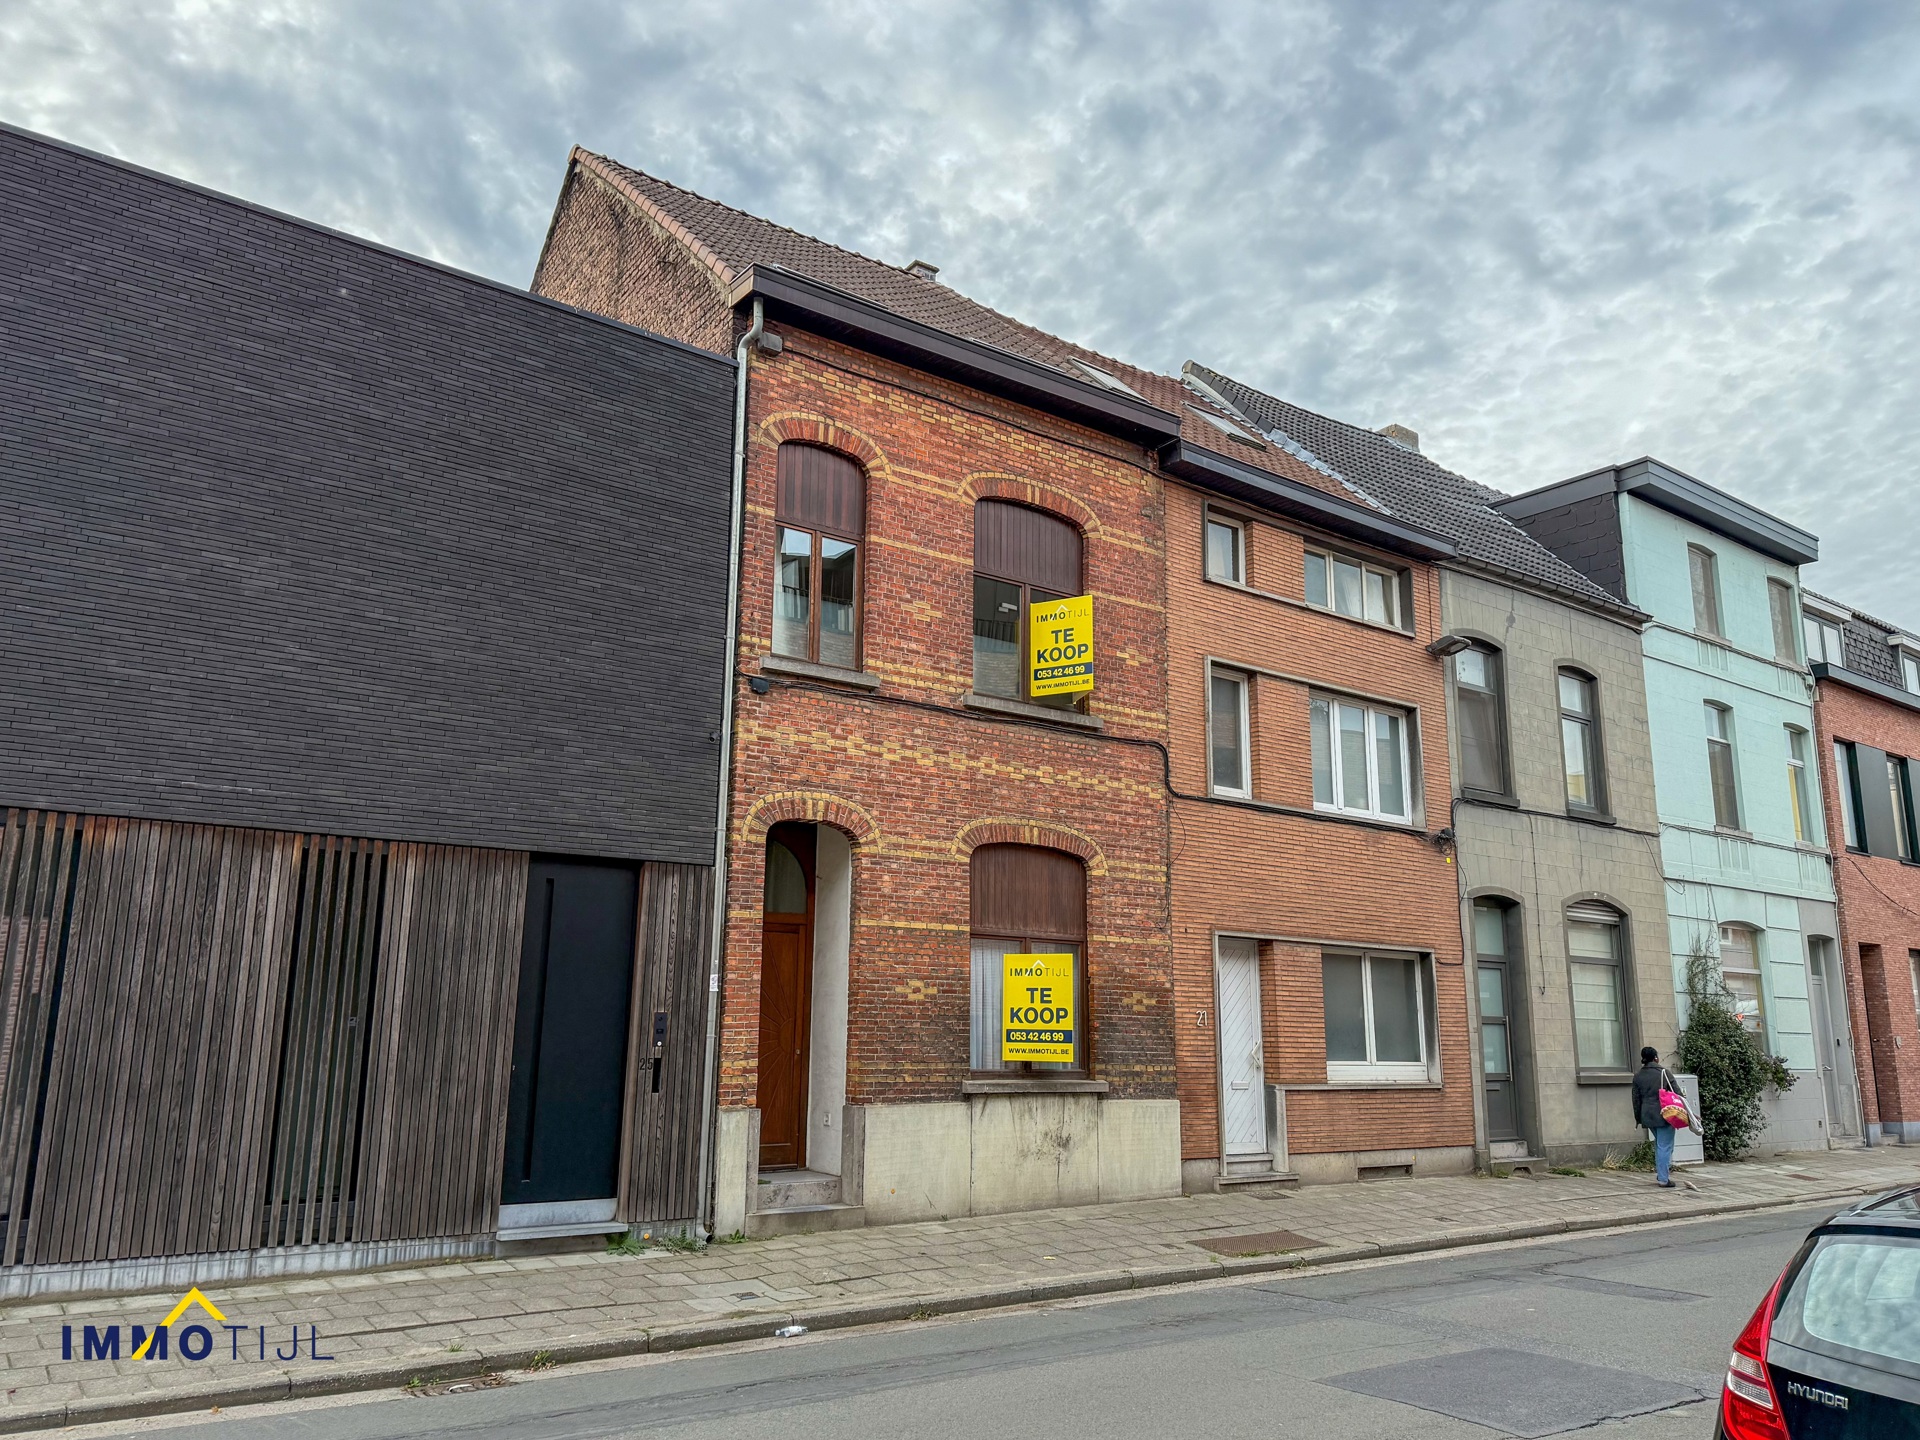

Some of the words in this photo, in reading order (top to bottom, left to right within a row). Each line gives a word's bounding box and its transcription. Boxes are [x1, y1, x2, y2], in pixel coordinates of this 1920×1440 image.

[1036, 608, 1090, 623] IMMOTIJL
[1051, 628, 1075, 644] TE
[1036, 643, 1089, 663] KOOP
[1037, 670, 1052, 678] 053
[1053, 668, 1063, 677] 42
[1063, 666, 1074, 675] 46
[1074, 665, 1086, 674] 99
[1036, 679, 1090, 690] WWW.IMMOTIJL.BE
[1009, 967, 1069, 977] IMMOTIJL
[1026, 987, 1053, 1004] TE
[1009, 1007, 1069, 1024] KOOP
[1196, 1010, 1208, 1027] 21
[1010, 1031, 1027, 1041] 053
[1027, 1031, 1039, 1041] 42
[1039, 1032, 1051, 1041] 46
[1052, 1032, 1064, 1041] 99
[1008, 1047, 1070, 1055] WWW.IMMOTIJL.BE
[639, 1057, 653, 1071] 25
[1787, 1381, 1849, 1410] HYUNDAI
